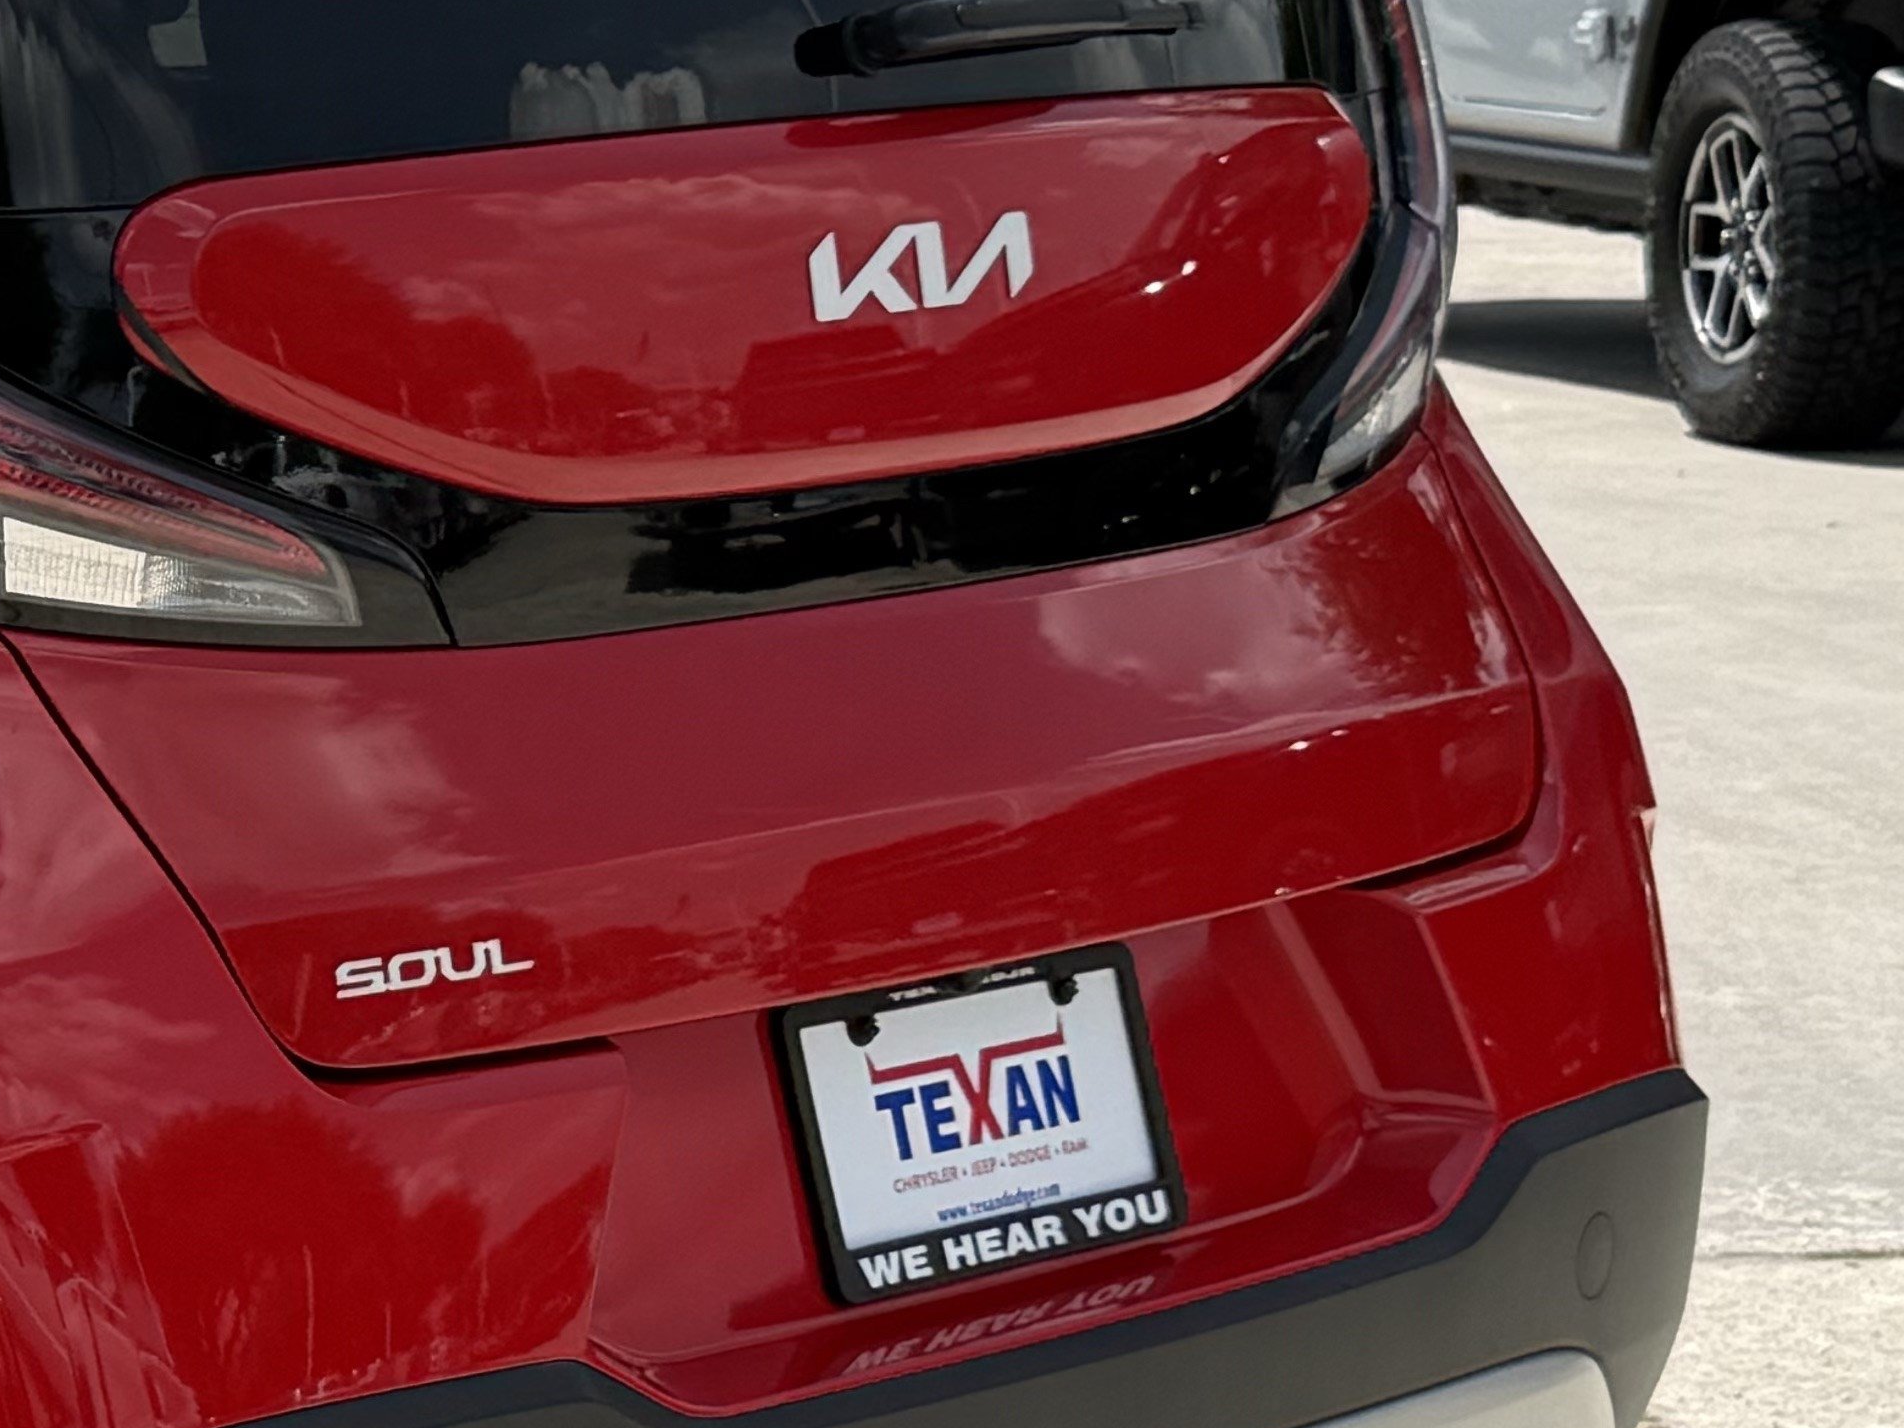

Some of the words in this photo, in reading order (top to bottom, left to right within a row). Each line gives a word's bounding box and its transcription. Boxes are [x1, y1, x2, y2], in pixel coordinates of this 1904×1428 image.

[808, 210, 1033, 322] KIA
[335, 938, 535, 999] SOUL
[866, 1012, 1081, 1161] TEXAN
[893, 1166, 958, 1194] CHRYSLER
[971, 1157, 996, 1177] JEEP
[1007, 1145, 1051, 1168] DODGE
[857, 1245, 934, 1289] WE
[942, 1215, 1068, 1271] HEAR
[1073, 1189, 1170, 1239] YOU
